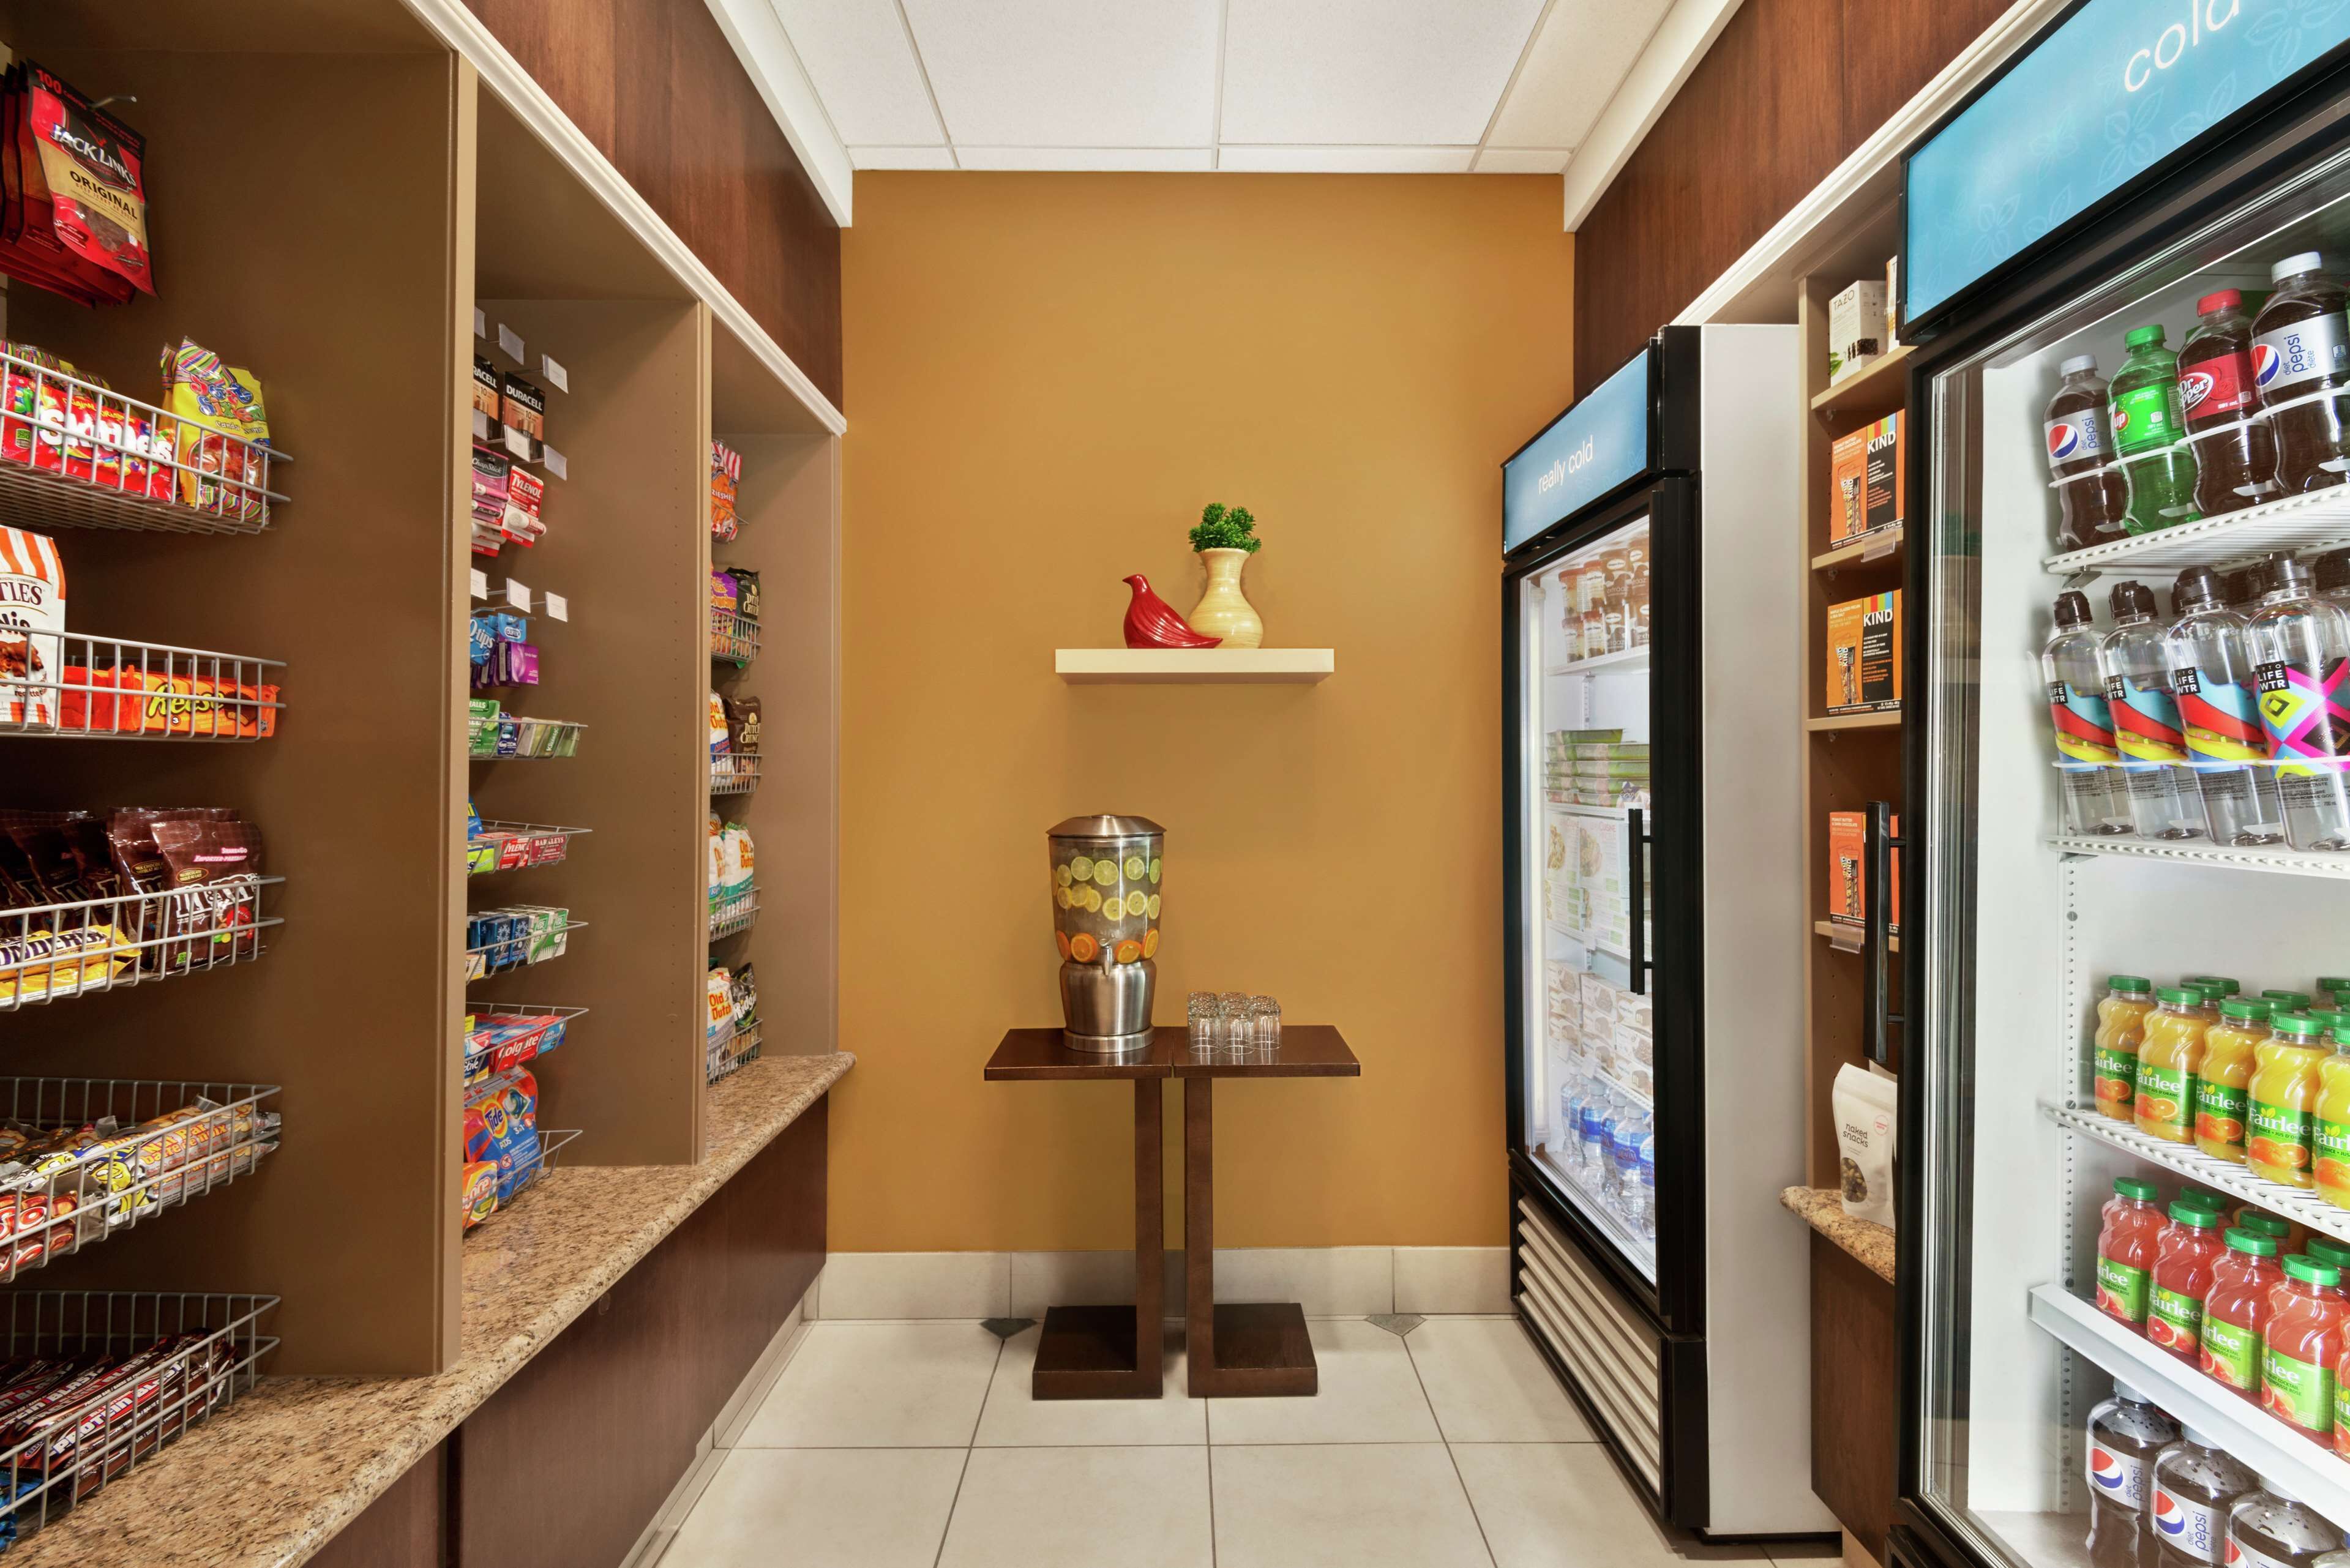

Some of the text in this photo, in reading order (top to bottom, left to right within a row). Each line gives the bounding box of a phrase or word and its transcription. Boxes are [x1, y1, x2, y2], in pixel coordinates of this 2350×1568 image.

[36, 69, 62, 94] 100
[69, 170, 138, 220] ORIGINAL
[1833, 289, 1855, 312] TAZO
[2284, 334, 2309, 373] pepsi
[2283, 362, 2292, 376] diet
[481, 386, 488, 397] 10
[2180, 378, 2194, 394] Dr
[506, 385, 543, 411] DURACELL
[525, 411, 533, 419] 10
[1868, 431, 1896, 455] KIND
[2082, 417, 2100, 449] pepsi
[1538, 435, 1593, 495] really cold
[512, 473, 541, 498] TYLENOL
[1863, 608, 1893, 627] KIND
[2176, 676, 2195, 685] LIFE
[2258, 670, 2283, 681] LIFE
[2260, 680, 2286, 691] WTR
[2108, 690, 2124, 700] WTR
[2177, 684, 2197, 694] WTR
[535, 837, 564, 846] BARLEYS
[709, 993, 724, 1007] Old
[711, 1005, 733, 1021] Dutch
[498, 1035, 540, 1059] Colgte
[2095, 1056, 2133, 1073] airlee
[2196, 1085, 2247, 1112] Fairlee
[484, 1107, 503, 1133] Tide
[2248, 1107, 2311, 1136] Fairlee
[1843, 1130, 1869, 1149] snacks
[1846, 1122, 1868, 1140] naked
[2149, 1288, 2201, 1321] Fairlee
[2129, 1465, 2144, 1503] pepsi
[2191, 1510, 2210, 1553] pepsi
